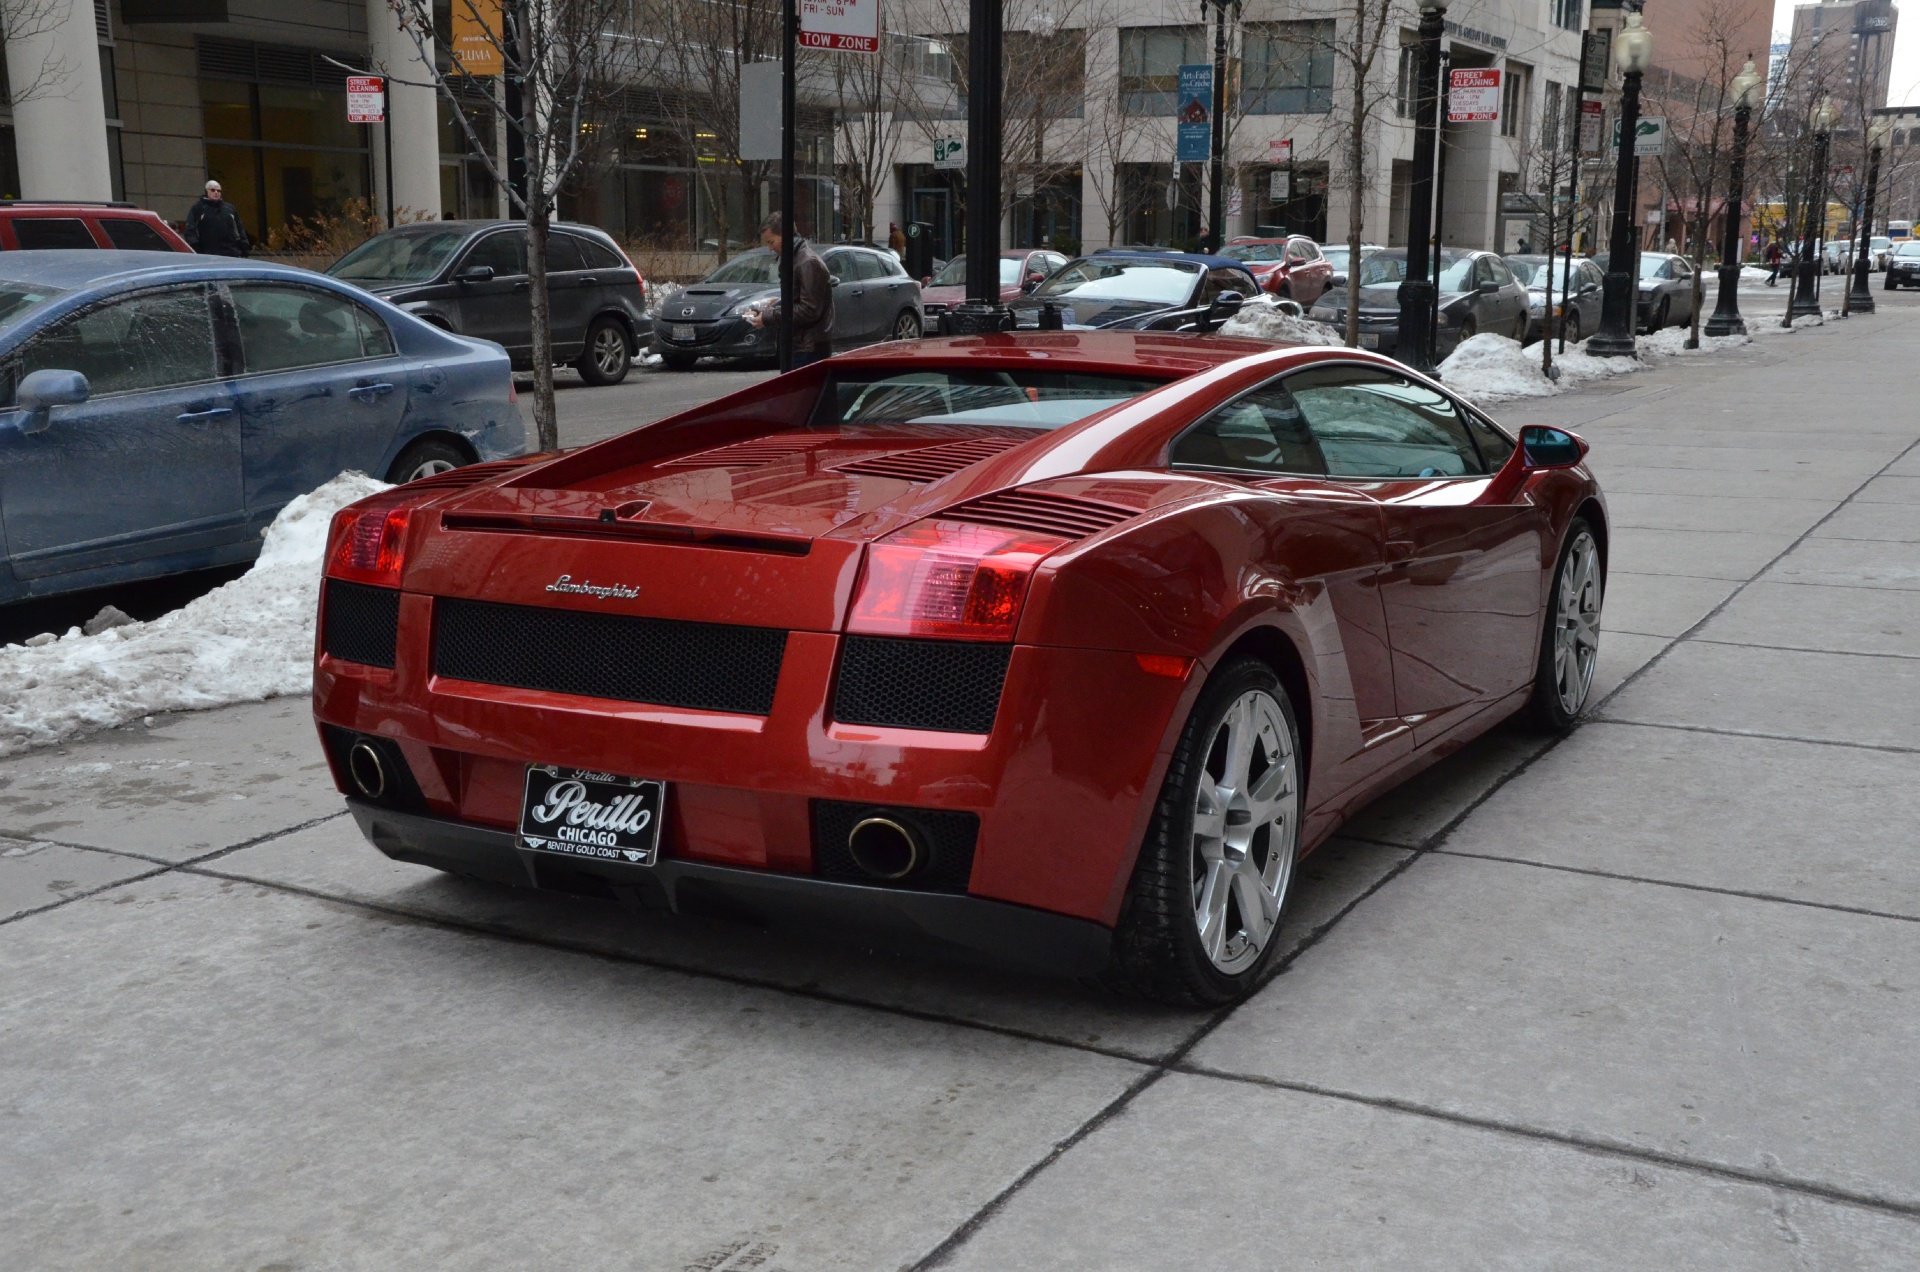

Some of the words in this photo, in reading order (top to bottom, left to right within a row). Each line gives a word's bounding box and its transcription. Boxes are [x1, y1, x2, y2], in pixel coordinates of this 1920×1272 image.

[804, 4, 818, 14] FRI
[826, 6, 845, 16] SUN
[804, 33, 831, 46] TOW
[838, 36, 871, 50] ZONE
[462, 49, 492, 61] LUMA
[1181, 71, 1192, 79] Art
[1454, 71, 1483, 79] STREET
[1453, 79, 1495, 87] CLEANING
[1472, 112, 1494, 120] ZONE
[546, 574, 640, 599] Lamborghini
[571, 769, 616, 782] Perillo
[532, 780, 651, 835] Perillo
[557, 826, 617, 846] CHICAGO
[547, 840, 575, 852] BENTLEY
[575, 844, 596, 856] GOLD
[597, 847, 621, 858] COAST
